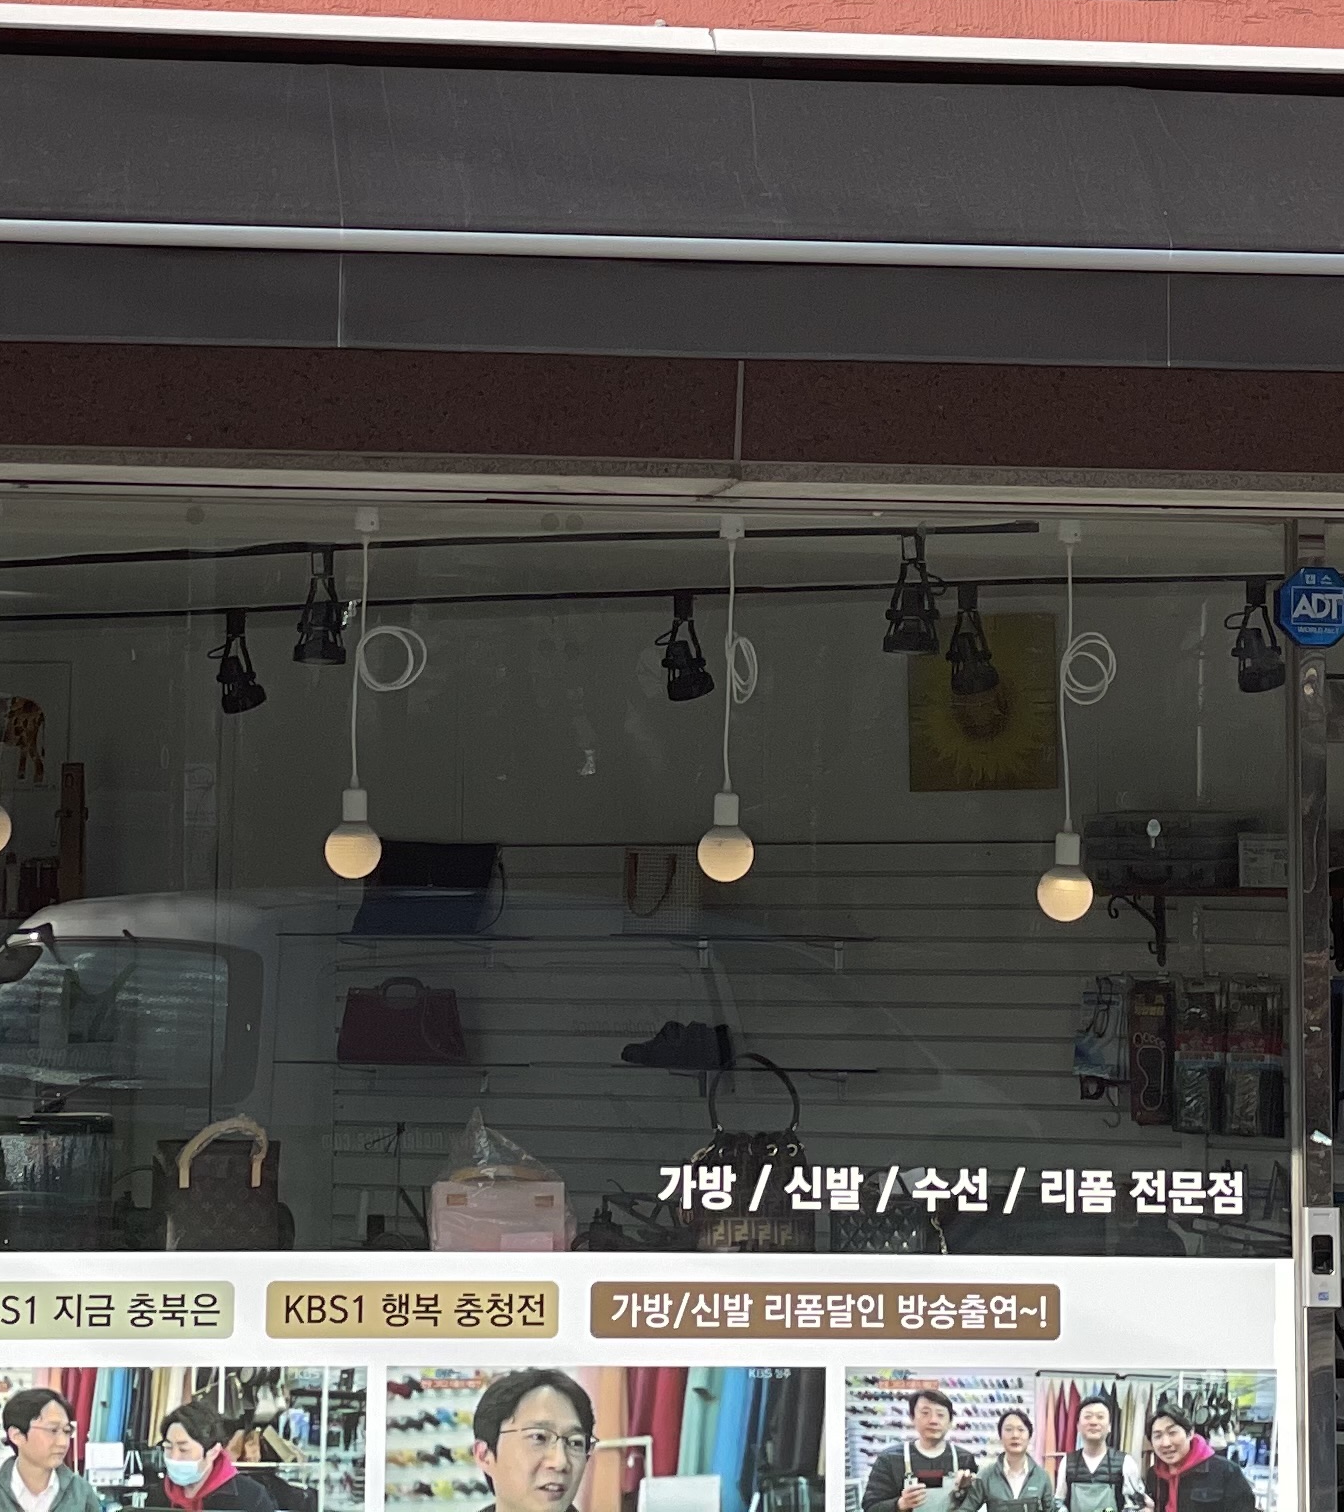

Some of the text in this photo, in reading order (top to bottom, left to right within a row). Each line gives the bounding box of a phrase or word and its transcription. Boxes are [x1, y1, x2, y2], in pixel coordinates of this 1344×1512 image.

[1292, 592, 1344, 620] ADT
[657, 1164, 737, 1210] 가방
[784, 1166, 864, 1211] 신발
[912, 1168, 988, 1212] 수선
[1041, 1169, 1117, 1214] 리폼
[1129, 1170, 1244, 1215] 전문점
[53, 1293, 116, 1328] 지금
[126, 1293, 221, 1328] 충북은
[284, 1293, 546, 1328] KBS1 행복 충청전
[610, 1292, 1048, 1330] 가방/신발 리폼달인 방송출연~!
